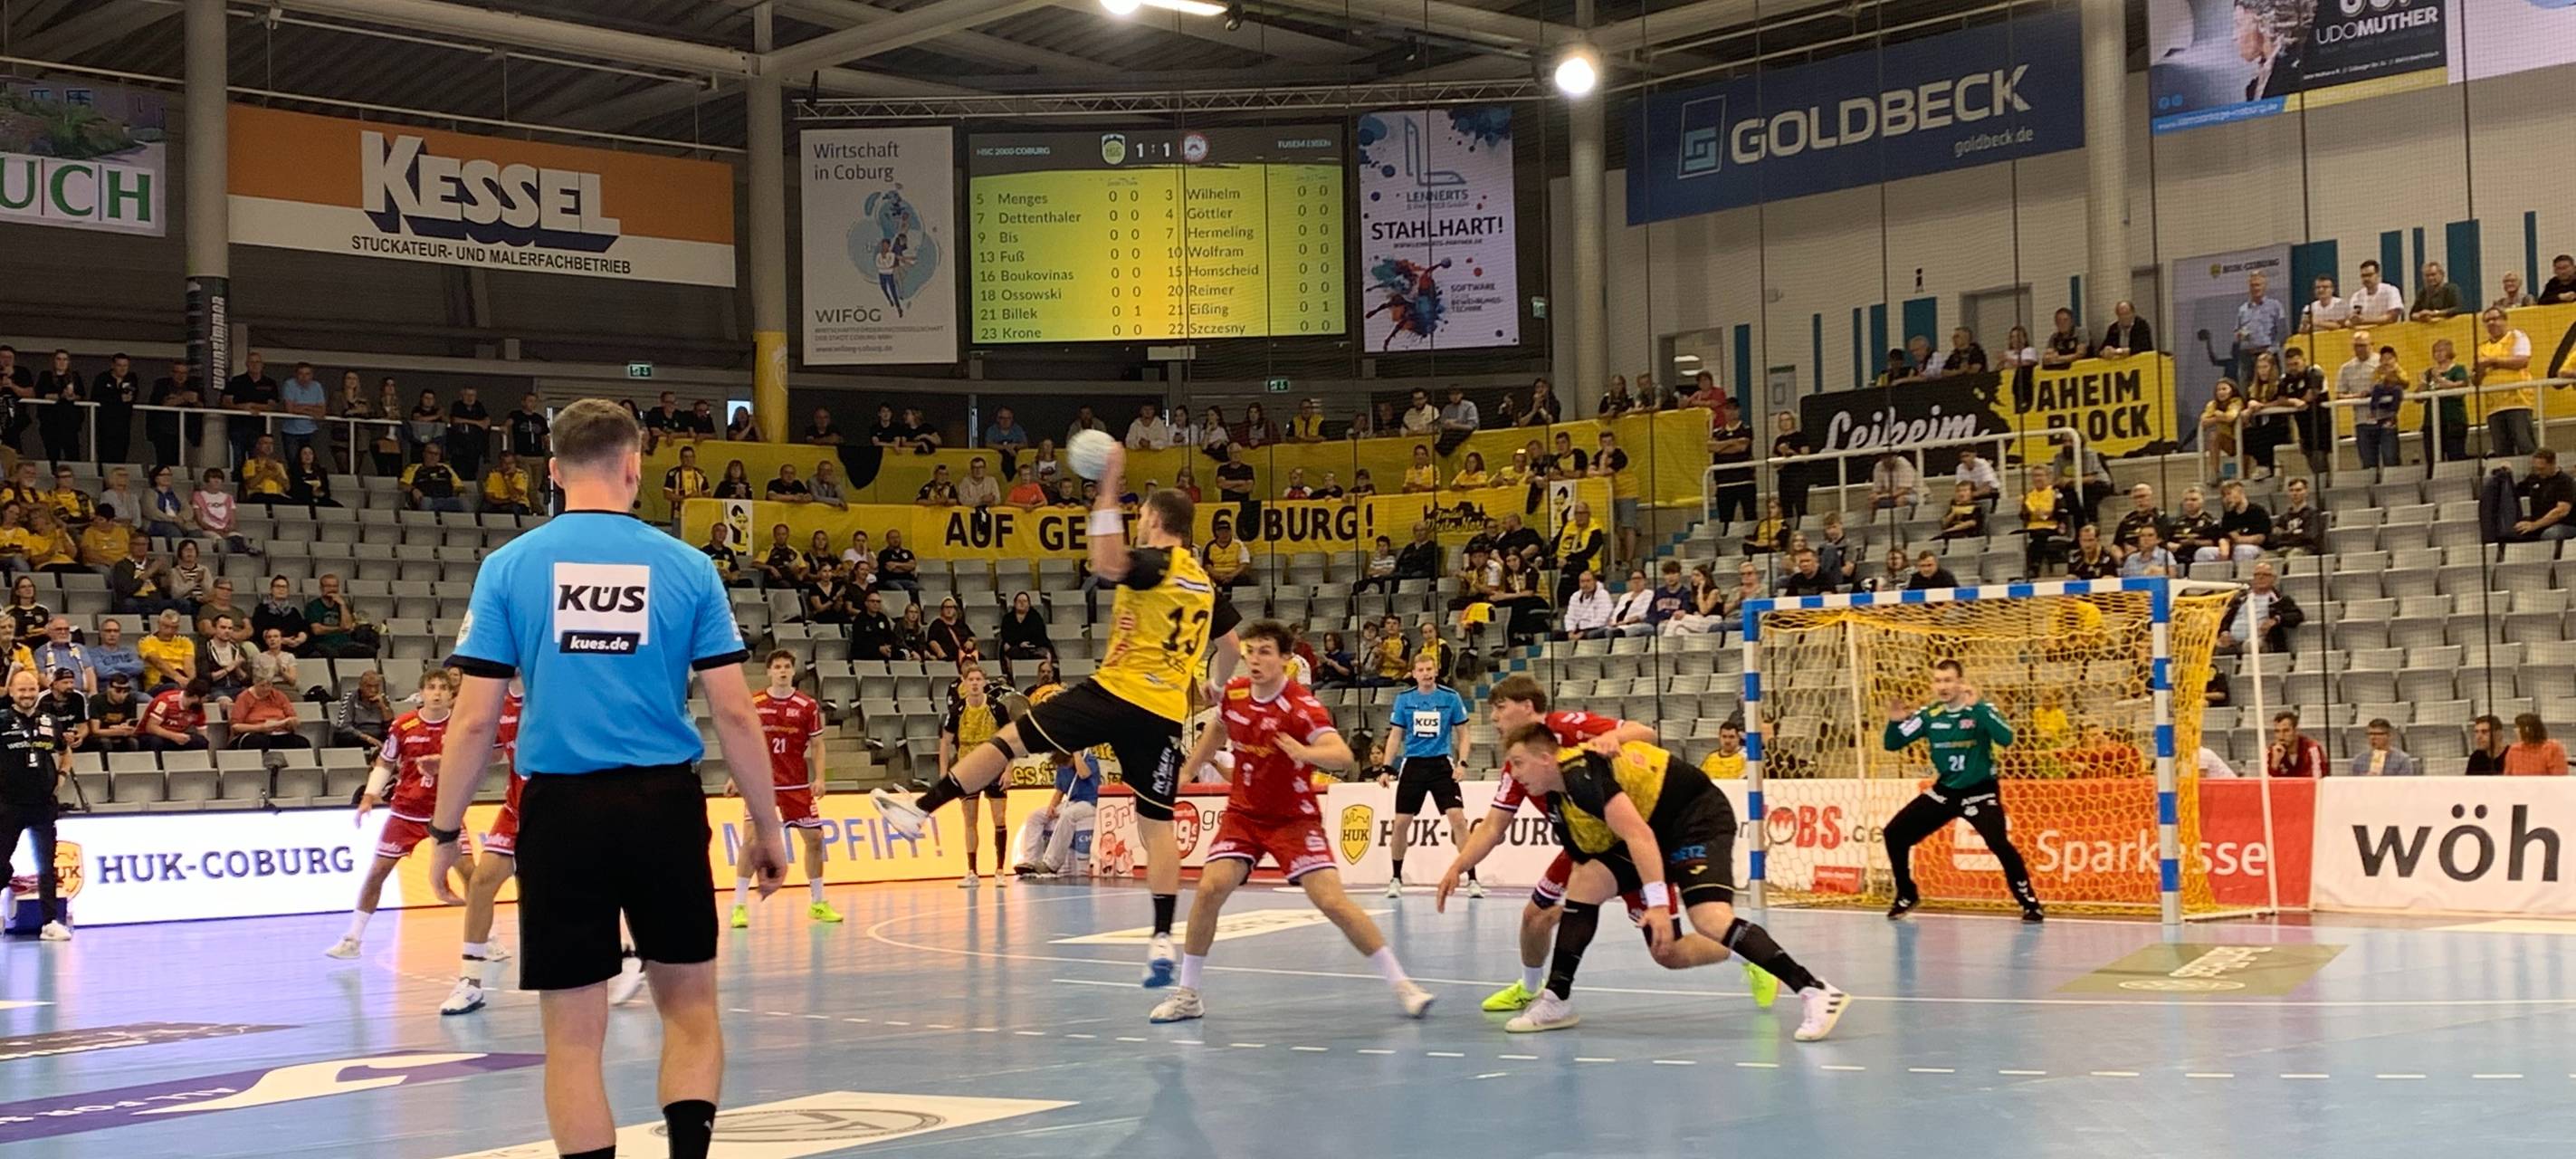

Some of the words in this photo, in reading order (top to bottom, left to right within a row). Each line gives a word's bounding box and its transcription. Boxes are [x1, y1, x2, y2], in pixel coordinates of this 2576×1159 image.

[2315, 5, 2439, 44] UDOMUTHER
[1730, 63, 2032, 165] GOLDBECK
[813, 140, 900, 158] Wirtschaft
[1137, 143, 1144, 158] 1
[1163, 142, 1170, 158] 1
[1954, 126, 2035, 158] goldbeck.de
[814, 165, 829, 180] in
[834, 164, 894, 182] Coburg
[362, 130, 620, 243] KESSEL
[1165, 189, 1173, 201] 3
[1187, 187, 1240, 200] Wilhelm
[1298, 186, 1306, 197] 0
[1320, 185, 1328, 196] 0
[977, 194, 984, 204] 5
[998, 193, 1048, 206] Menges
[1109, 191, 1118, 202] 0
[1131, 190, 1139, 201] 0
[977, 213, 985, 224] 7
[998, 212, 1082, 224] Dettenthaler
[1110, 210, 1118, 221] 0
[1131, 209, 1140, 221] 0
[1165, 208, 1173, 219] 4
[1298, 205, 1306, 216] 0
[1320, 204, 1328, 216] 0
[978, 232, 986, 244] 9
[999, 232, 1018, 244] Bis
[1110, 229, 1119, 241] 0
[1131, 229, 1140, 240] 0
[1166, 228, 1174, 239] 7
[1188, 226, 1254, 241] Hermeling
[1298, 225, 1307, 236] 0
[1320, 224, 1329, 235] 0
[1370, 216, 1503, 241] STAHLHART!
[351, 235, 453, 259] STUCKATEUR-
[455, 245, 486, 263] UND
[489, 249, 632, 274] MALERFACHBETRIEB
[979, 251, 995, 263] 13
[1000, 250, 1025, 263] Fuß
[1111, 248, 1119, 260] 0
[1131, 247, 1140, 259] 0
[1168, 247, 1183, 259] 10
[1188, 245, 1244, 258] Wolfram
[1299, 244, 1307, 255] 0
[1321, 243, 1329, 254] 0
[980, 271, 996, 283] 16
[1001, 270, 1074, 283] Boukovinas
[1111, 267, 1120, 279] 0
[1132, 267, 1140, 279] 0
[1169, 266, 1182, 277] 15
[1299, 263, 1308, 274] 0
[1321, 262, 1330, 273] 0
[980, 290, 996, 302] 18
[1001, 288, 1062, 301] Ossowski
[1111, 286, 1120, 298] 0
[1133, 286, 1141, 298] 0
[1168, 285, 1183, 297] 20
[1189, 284, 1235, 296] Reimer
[1299, 282, 1308, 293] 0
[1321, 282, 1330, 292] 0
[815, 305, 882, 323] WIFÖG
[980, 309, 997, 321] 21
[1002, 308, 1038, 320] Billek
[1112, 306, 1121, 317] 0
[1134, 305, 1141, 316] 1
[1169, 304, 1183, 316] 21
[1189, 303, 1229, 316] Eißing
[1300, 302, 1308, 312] 0
[1322, 301, 1330, 311] 1
[981, 328, 997, 340] 23
[1003, 328, 1042, 339] Krone
[1112, 325, 1121, 336] 0
[1134, 324, 1142, 336] 0
[1169, 323, 1184, 335] 22
[1189, 323, 1245, 336] Szczesny
[1301, 321, 1309, 332] 0
[1321, 320, 1330, 331] 0
[945, 511, 1014, 549] AUF
[557, 584, 646, 613] KÜS
[1161, 606, 1209, 656] 13
[569, 635, 630, 650] kues.de
[772, 738, 787, 753] 21
[1341, 828, 1369, 842] HUK
[2352, 802, 2561, 882] wöh
[97, 845, 355, 884] HUK-COBURG
